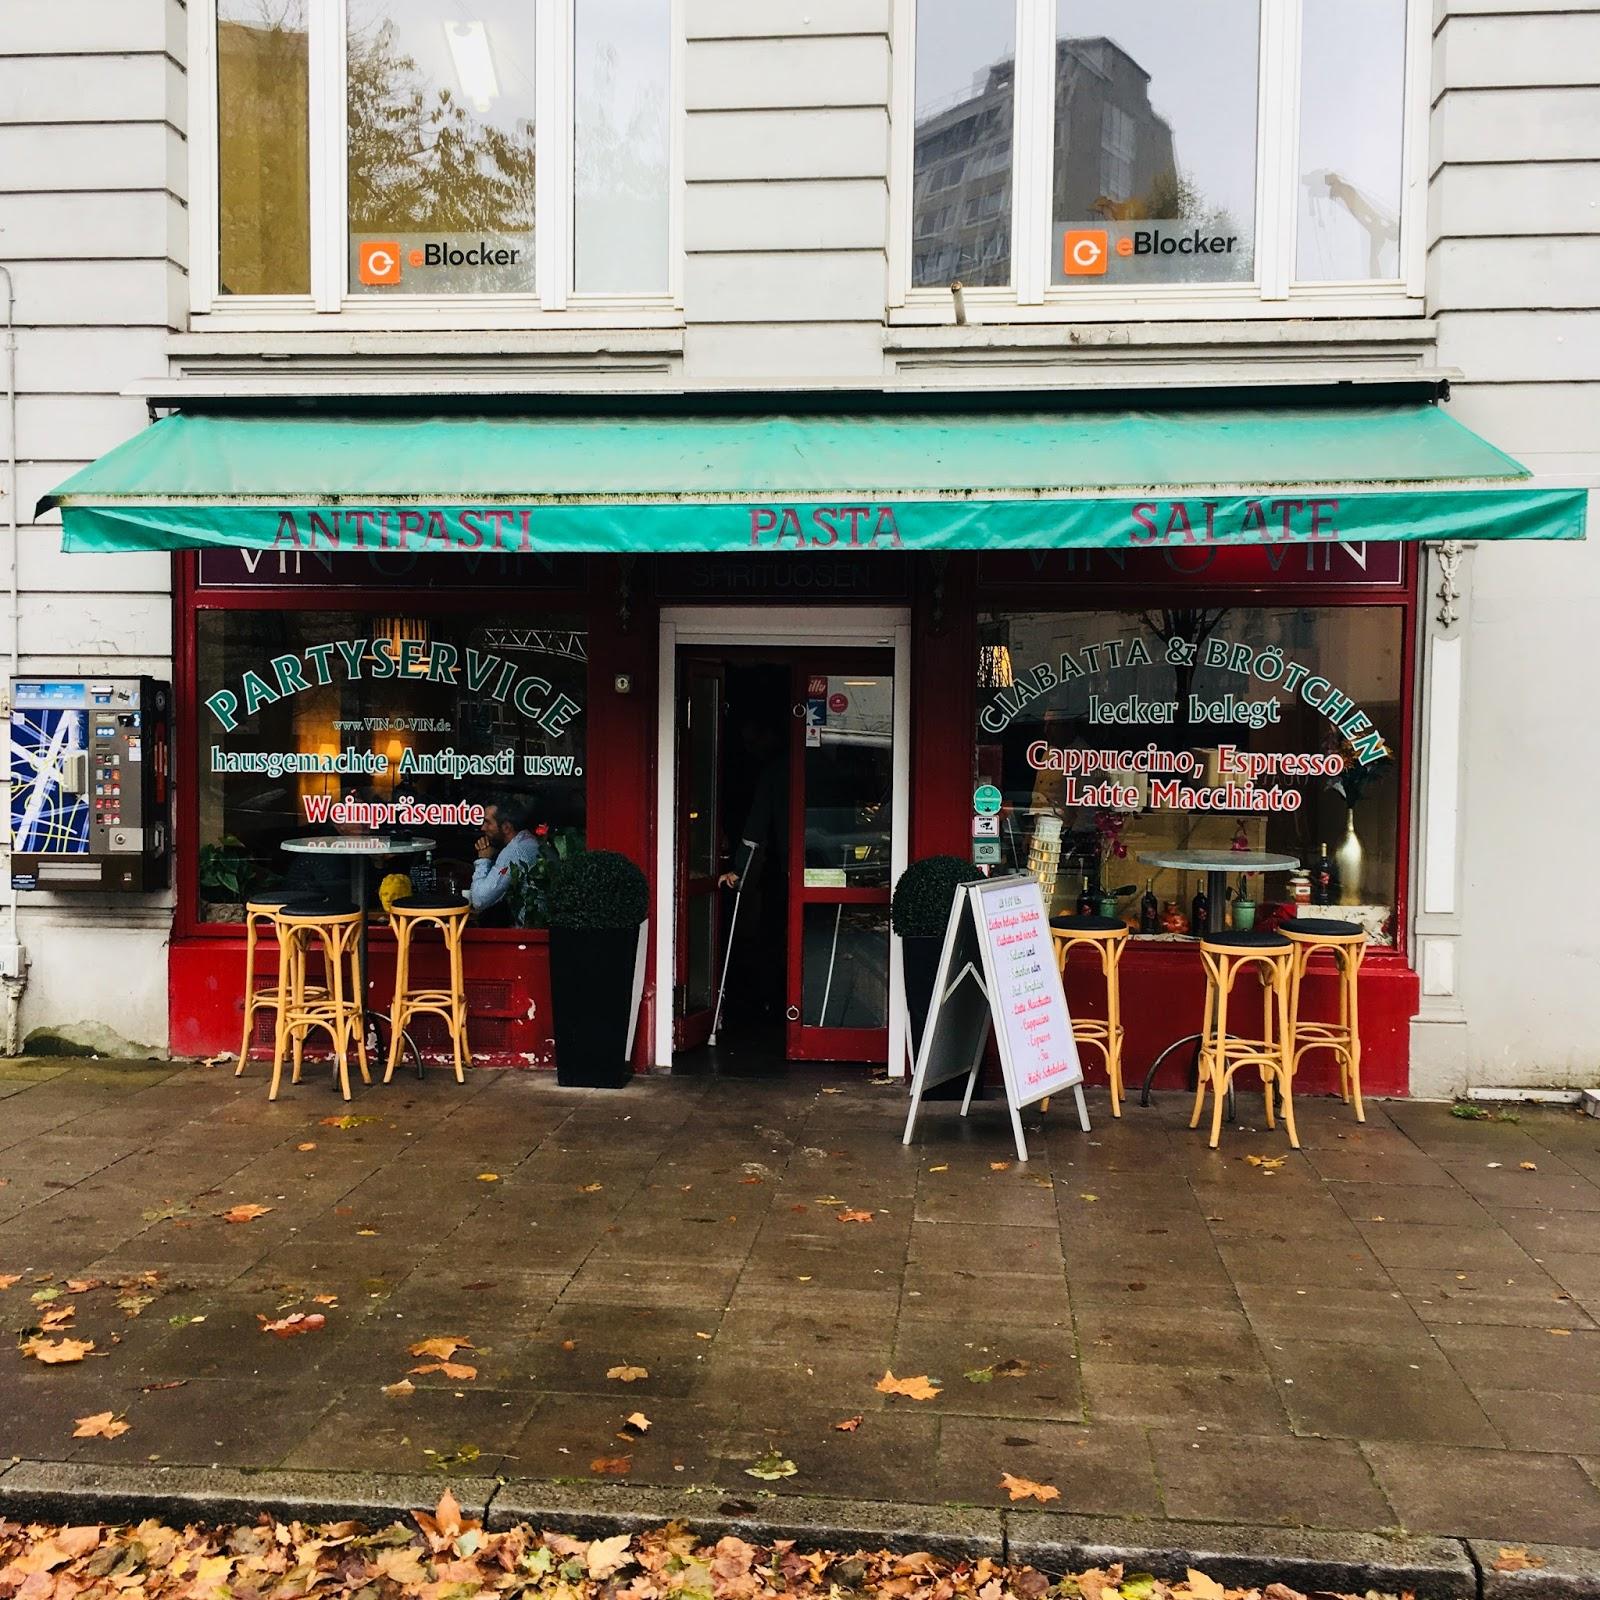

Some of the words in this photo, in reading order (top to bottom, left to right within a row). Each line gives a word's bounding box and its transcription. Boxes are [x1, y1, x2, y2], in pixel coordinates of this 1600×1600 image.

[408, 242, 521, 267] eBlocker
[1116, 230, 1238, 256] eBlocker
[272, 510, 533, 550] ANTIPASTI
[748, 507, 905, 548] PASTA
[1130, 499, 1340, 545] SALATE
[693, 560, 870, 588] SPIRITUOSEN
[204, 638, 582, 739] PARTYSERVICE
[980, 636, 1152, 734] CIABATTA
[1164, 636, 1198, 667] &
[1204, 638, 1388, 767] BRÖTCHEN
[332, 717, 452, 733] www.VIN-O-VIN.de
[1088, 695, 1179, 725] lecker
[1188, 693, 1281, 729] belegt
[210, 745, 389, 778] hausgemachte
[399, 746, 516, 780] Antipasti
[524, 754, 583, 778] usw.
[1026, 740, 1204, 780] Cappuccino,
[1217, 744, 1345, 780] Espresso
[302, 794, 486, 830] Weinpräsente
[1065, 777, 1139, 808] Latte
[1150, 778, 1302, 812] Macchiato
